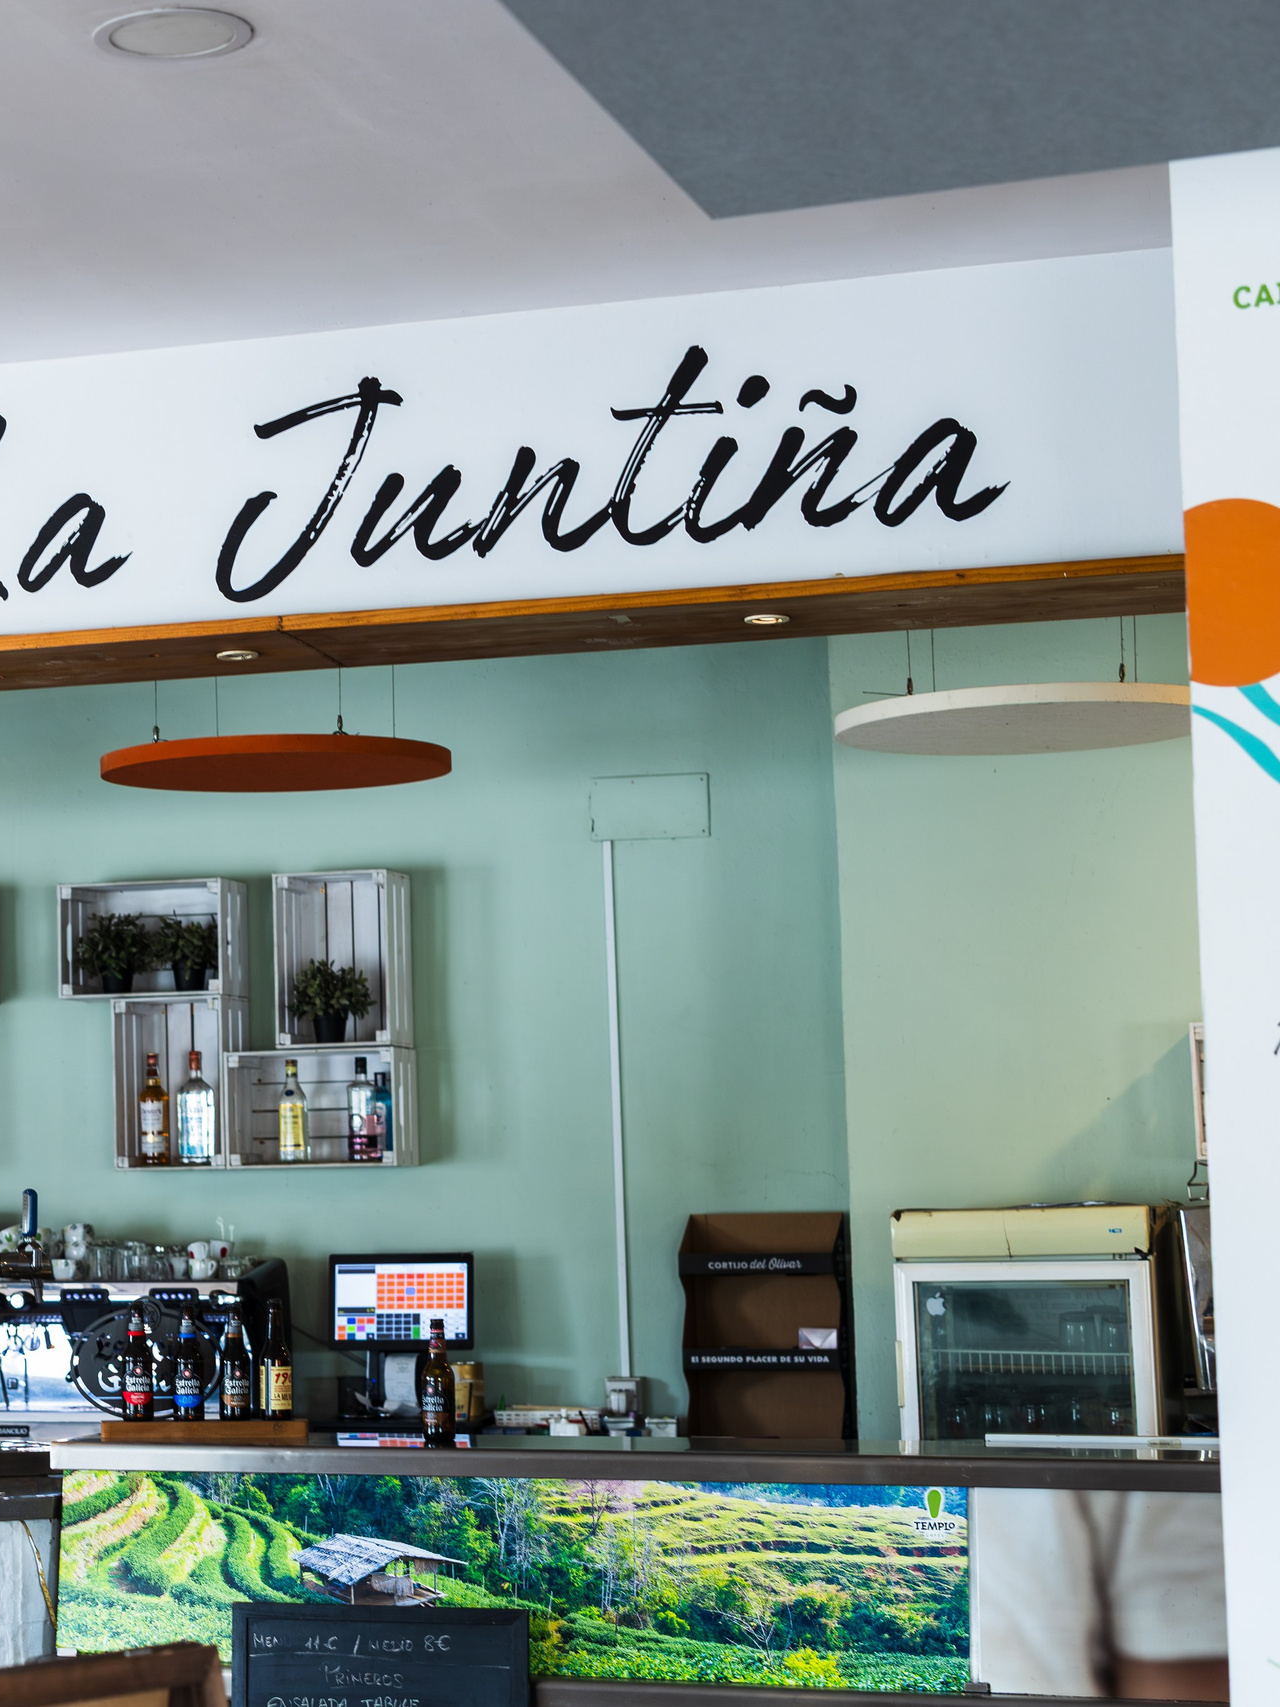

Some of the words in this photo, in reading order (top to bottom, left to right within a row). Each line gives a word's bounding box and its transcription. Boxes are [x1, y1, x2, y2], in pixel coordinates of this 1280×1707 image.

[214, 345, 1010, 602] Juntiña
[708, 1261, 748, 1269] CORTIJO
[750, 1259, 766, 1269] del
[768, 1257, 803, 1270] Olivar
[125, 1375, 151, 1384] Estrella
[175, 1378, 200, 1387] Estrella
[224, 1378, 249, 1387] Estrella
[125, 1384, 150, 1392] Galicia
[175, 1386, 200, 1395] Galicia
[224, 1386, 249, 1395] Galicia
